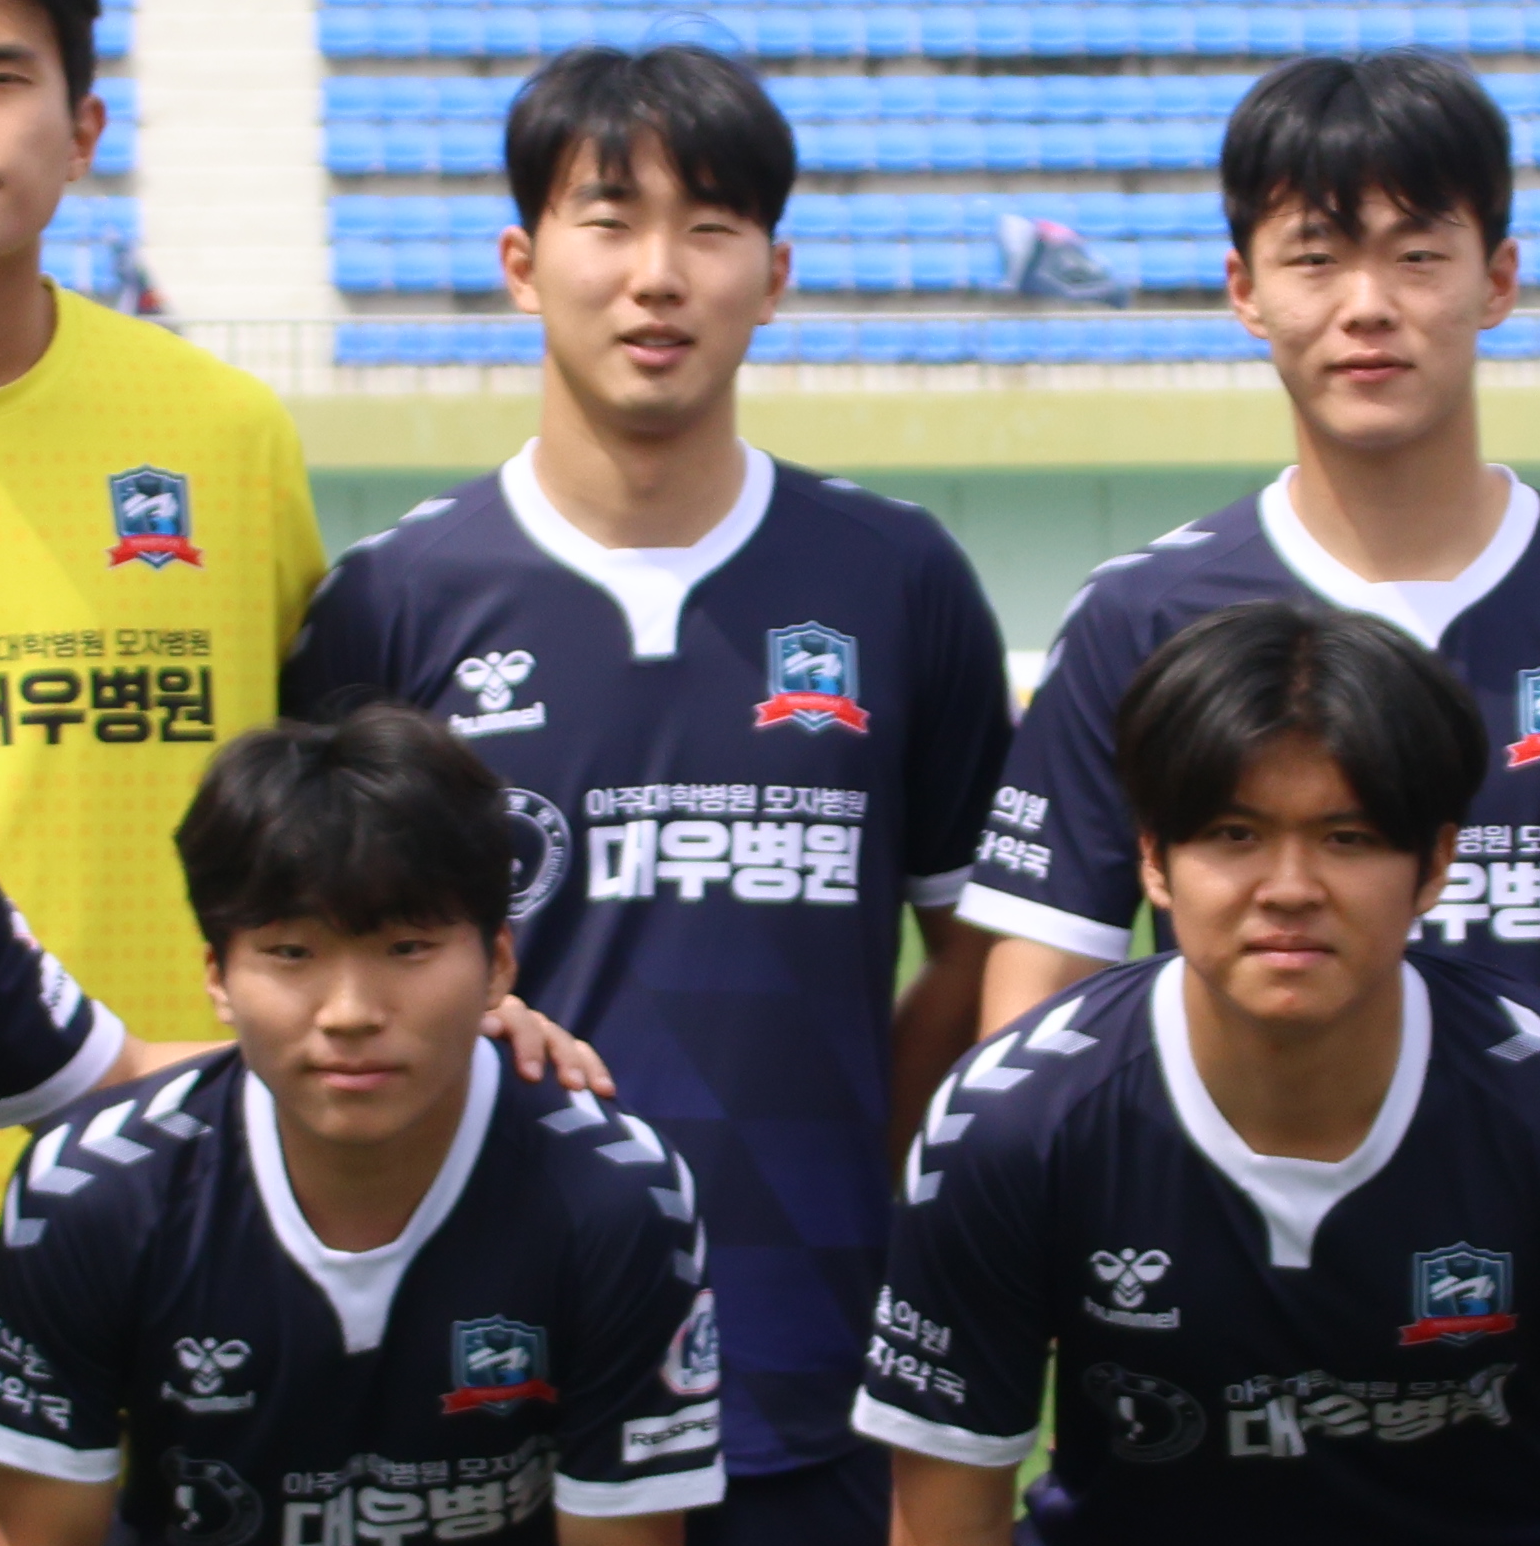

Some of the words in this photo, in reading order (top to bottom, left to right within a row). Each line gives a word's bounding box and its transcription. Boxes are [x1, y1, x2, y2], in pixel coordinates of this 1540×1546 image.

[115, 628, 211, 657] 모자병원
[585, 783, 757, 816] 아주대학병원
[763, 785, 868, 818] 모자병원
[587, 819, 862, 902] 대우병원
[1082, 1296, 1181, 1329] hummel
